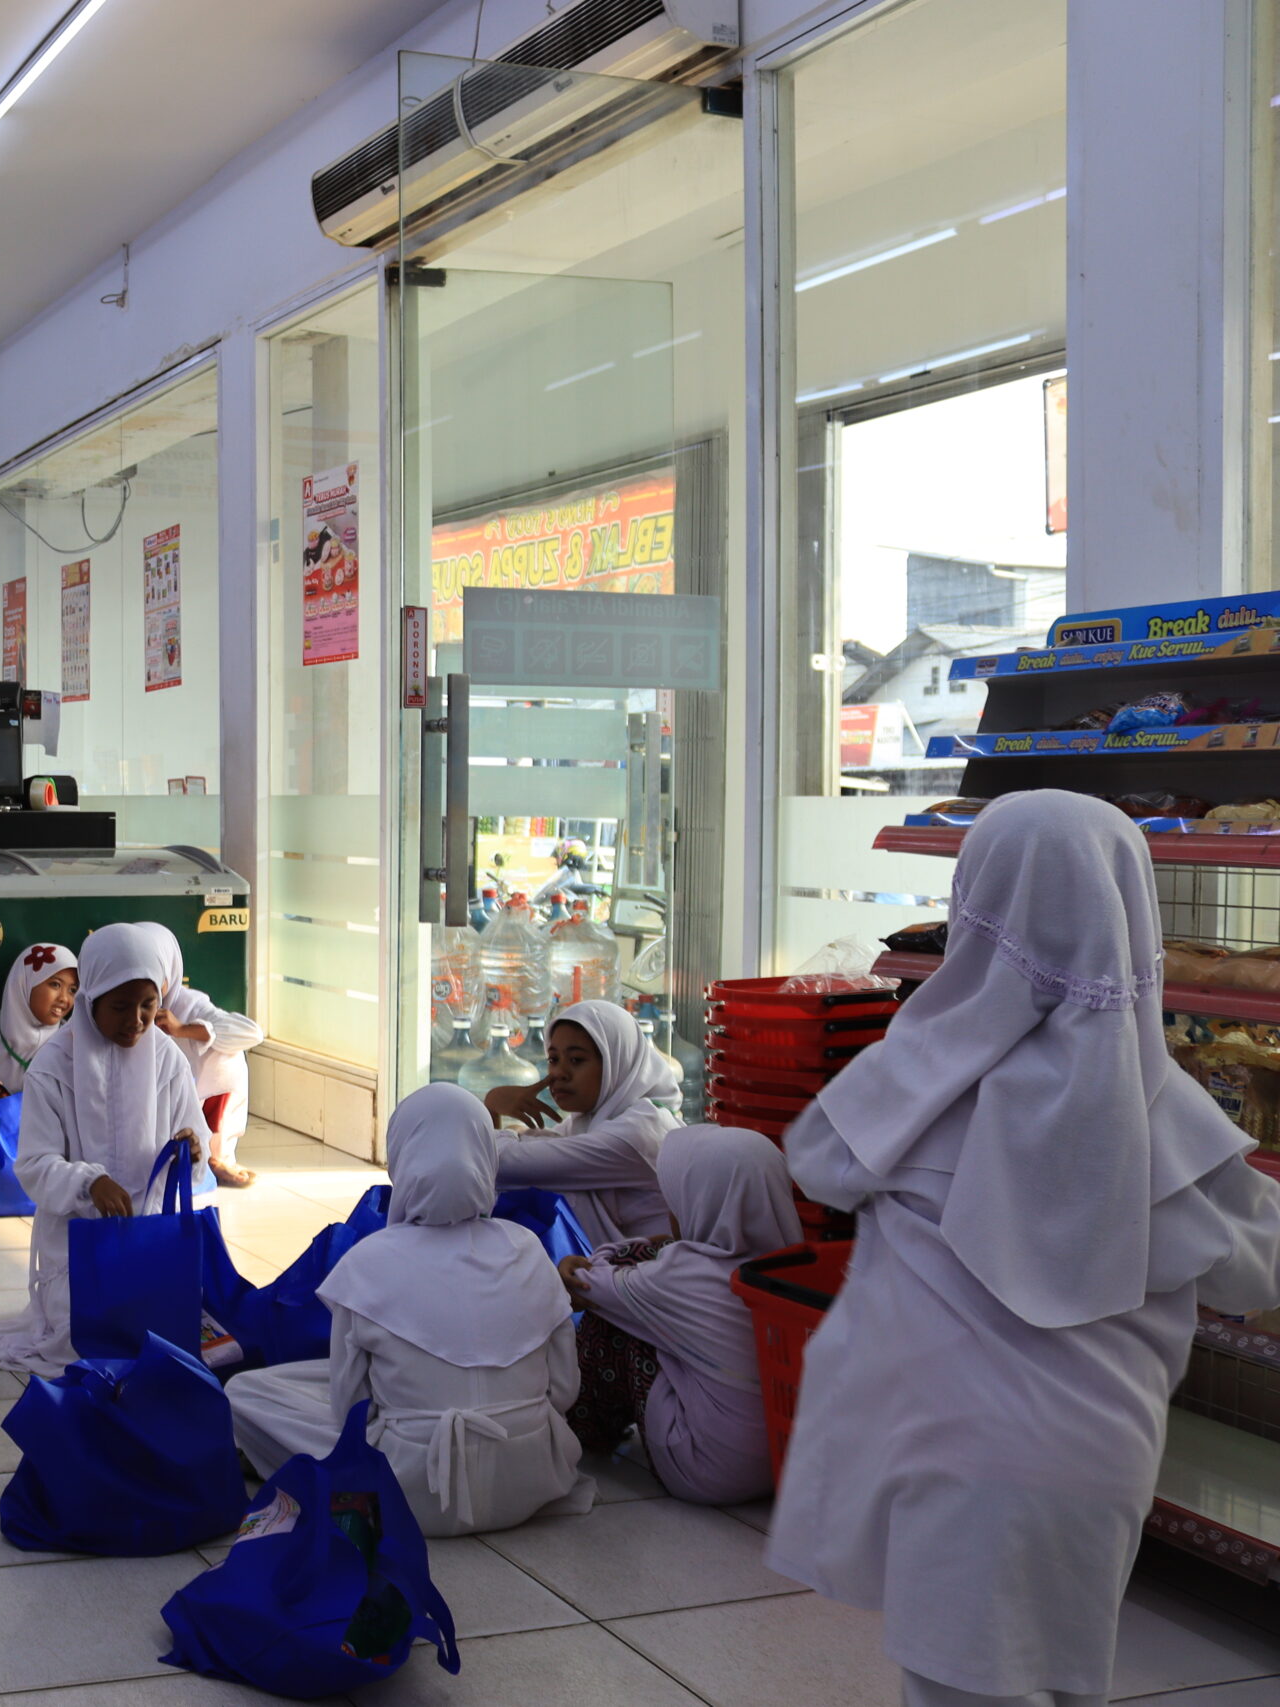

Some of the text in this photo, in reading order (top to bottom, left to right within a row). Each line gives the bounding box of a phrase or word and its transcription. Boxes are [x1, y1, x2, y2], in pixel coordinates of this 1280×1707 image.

[1147, 609, 1210, 640] Break
[412, 621, 420, 678] DORONG
[1017, 653, 1056, 671] Break
[1093, 649, 1123, 666] enjoy
[1128, 643, 1156, 661] Kue
[995, 735, 1033, 752] Break
[1070, 735, 1099, 752] enjoy
[1104, 733, 1132, 748] Kue
[209, 914, 248, 926] BARU
